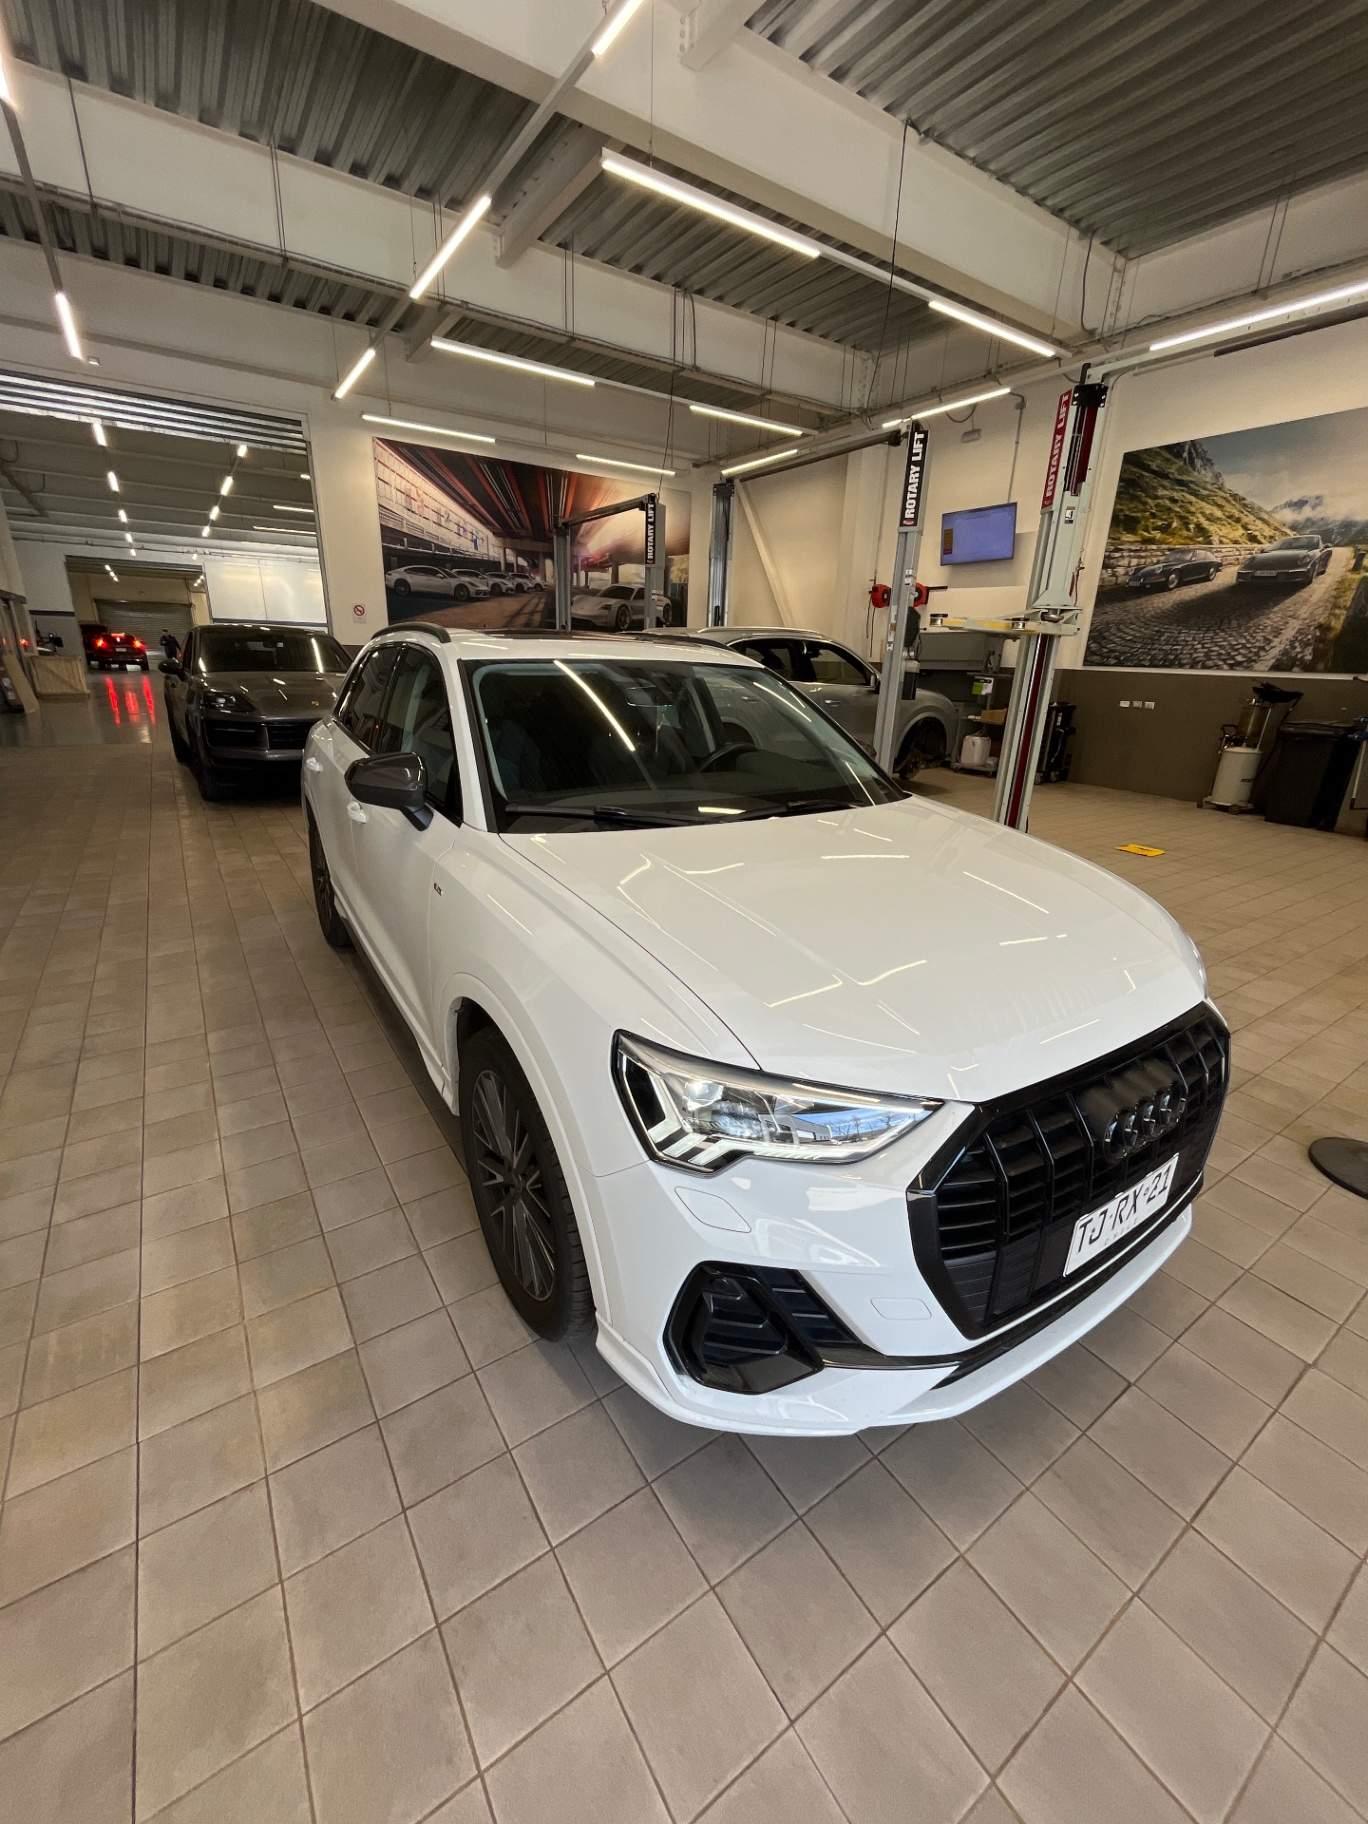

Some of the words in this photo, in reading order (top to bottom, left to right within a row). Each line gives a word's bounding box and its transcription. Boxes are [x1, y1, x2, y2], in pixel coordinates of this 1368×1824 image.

[911, 431, 925, 461] LIFT
[1045, 434, 1062, 498] ROTARY
[1057, 394, 1069, 429] LIFT
[647, 503, 655, 522] LIFT
[904, 465, 920, 519] ROTARY
